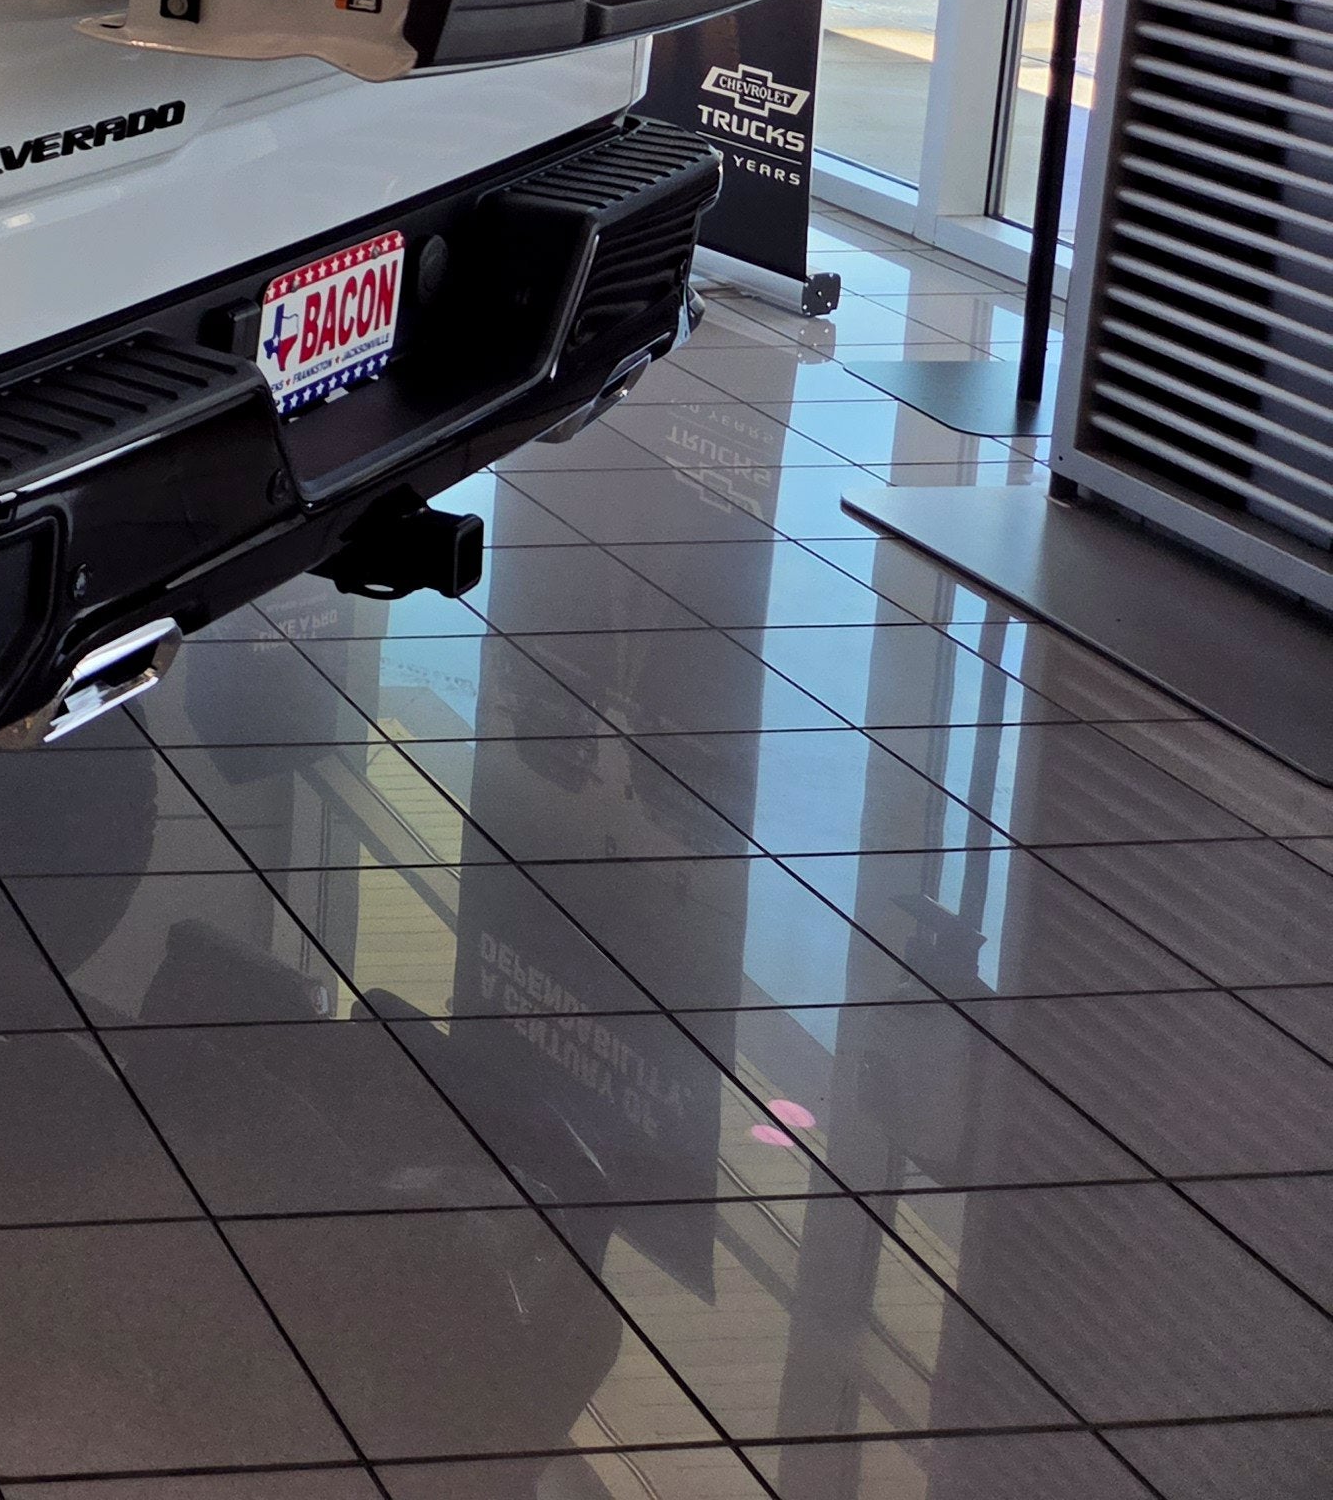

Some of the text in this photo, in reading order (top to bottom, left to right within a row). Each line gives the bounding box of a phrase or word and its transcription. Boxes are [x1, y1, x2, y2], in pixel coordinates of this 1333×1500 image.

[718, 75, 791, 105] CHEVROLET
[696, 104, 805, 152] TRUCKS
[732, 154, 801, 186] YEARS
[298, 259, 398, 364] BACON
[293, 358, 333, 384] FRANKSTON
[342, 332, 390, 361] JACKSONVILLE
